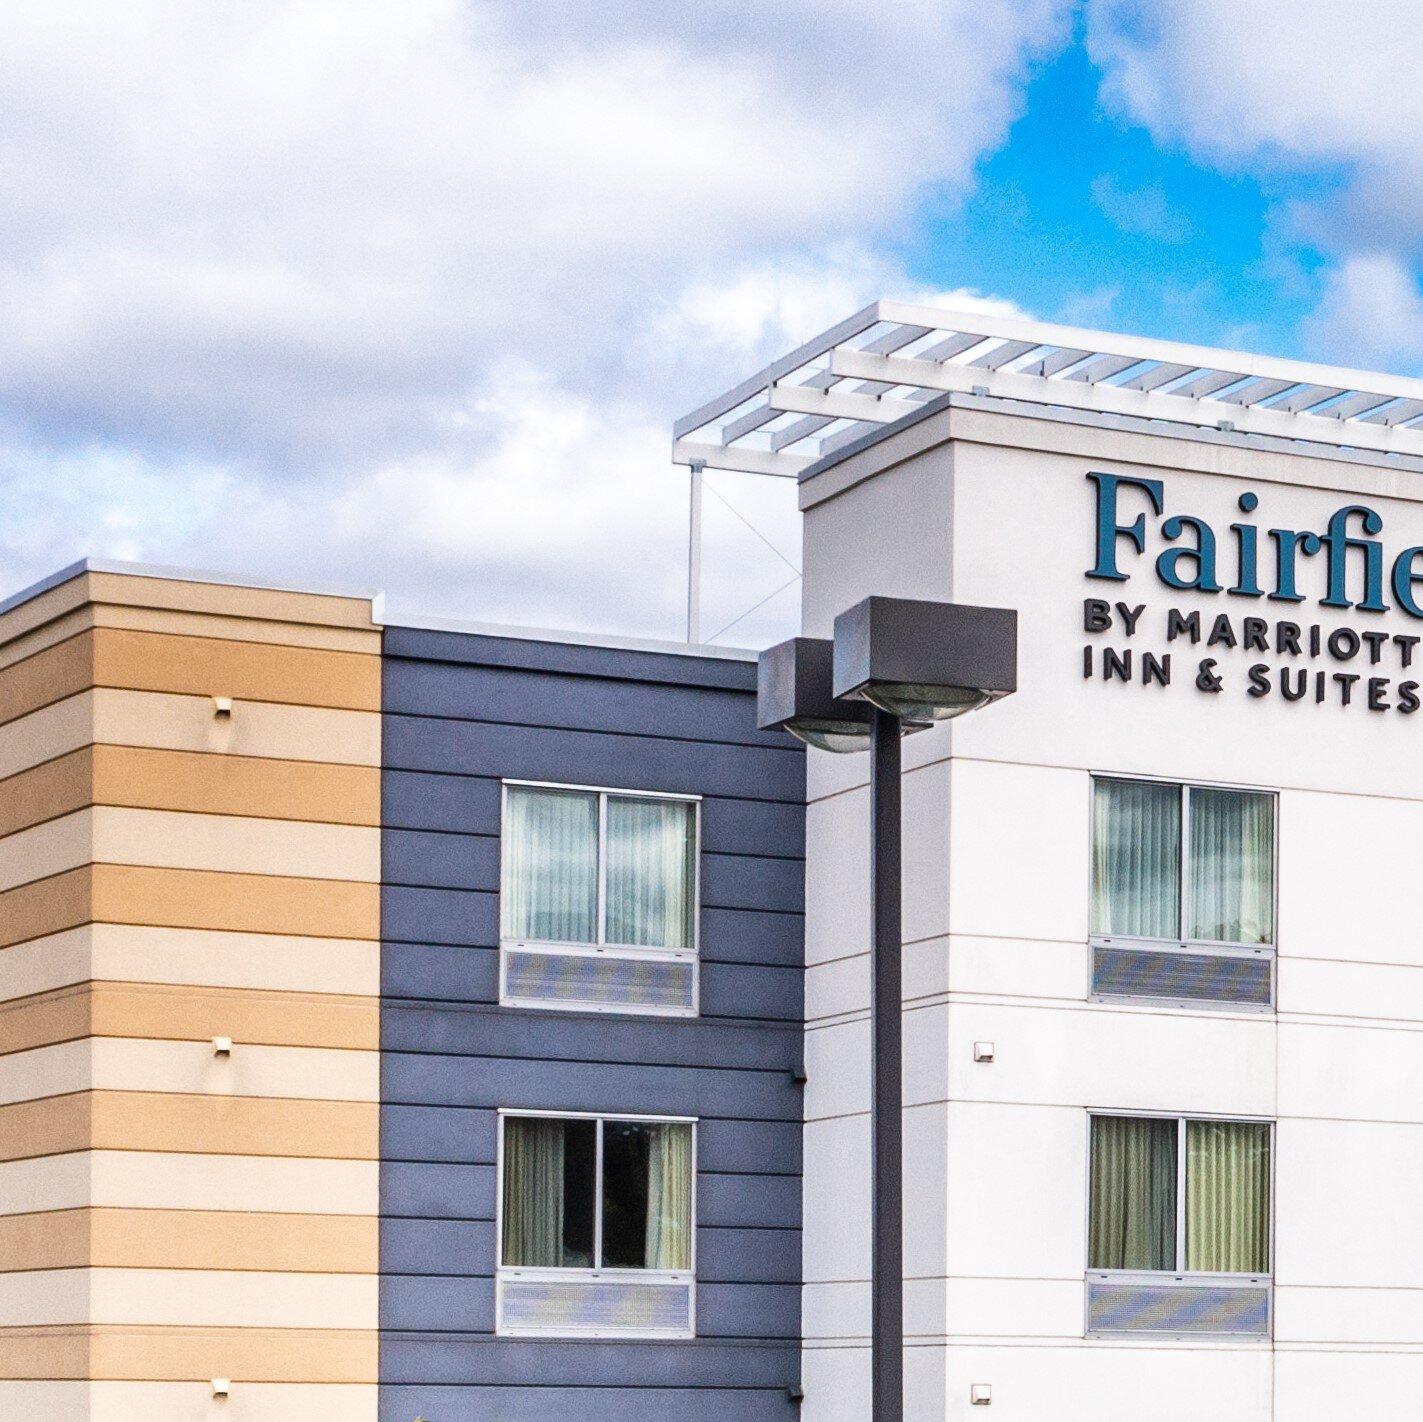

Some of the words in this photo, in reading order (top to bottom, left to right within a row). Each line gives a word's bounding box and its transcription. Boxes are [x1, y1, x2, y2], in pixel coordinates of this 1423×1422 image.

[1083, 598, 1147, 638] BY
[1166, 608, 1421, 669] MARRIOTT
[1083, 645, 1171, 688] INN
[1195, 657, 1224, 695] &
[1246, 663, 1421, 716] SUITES
